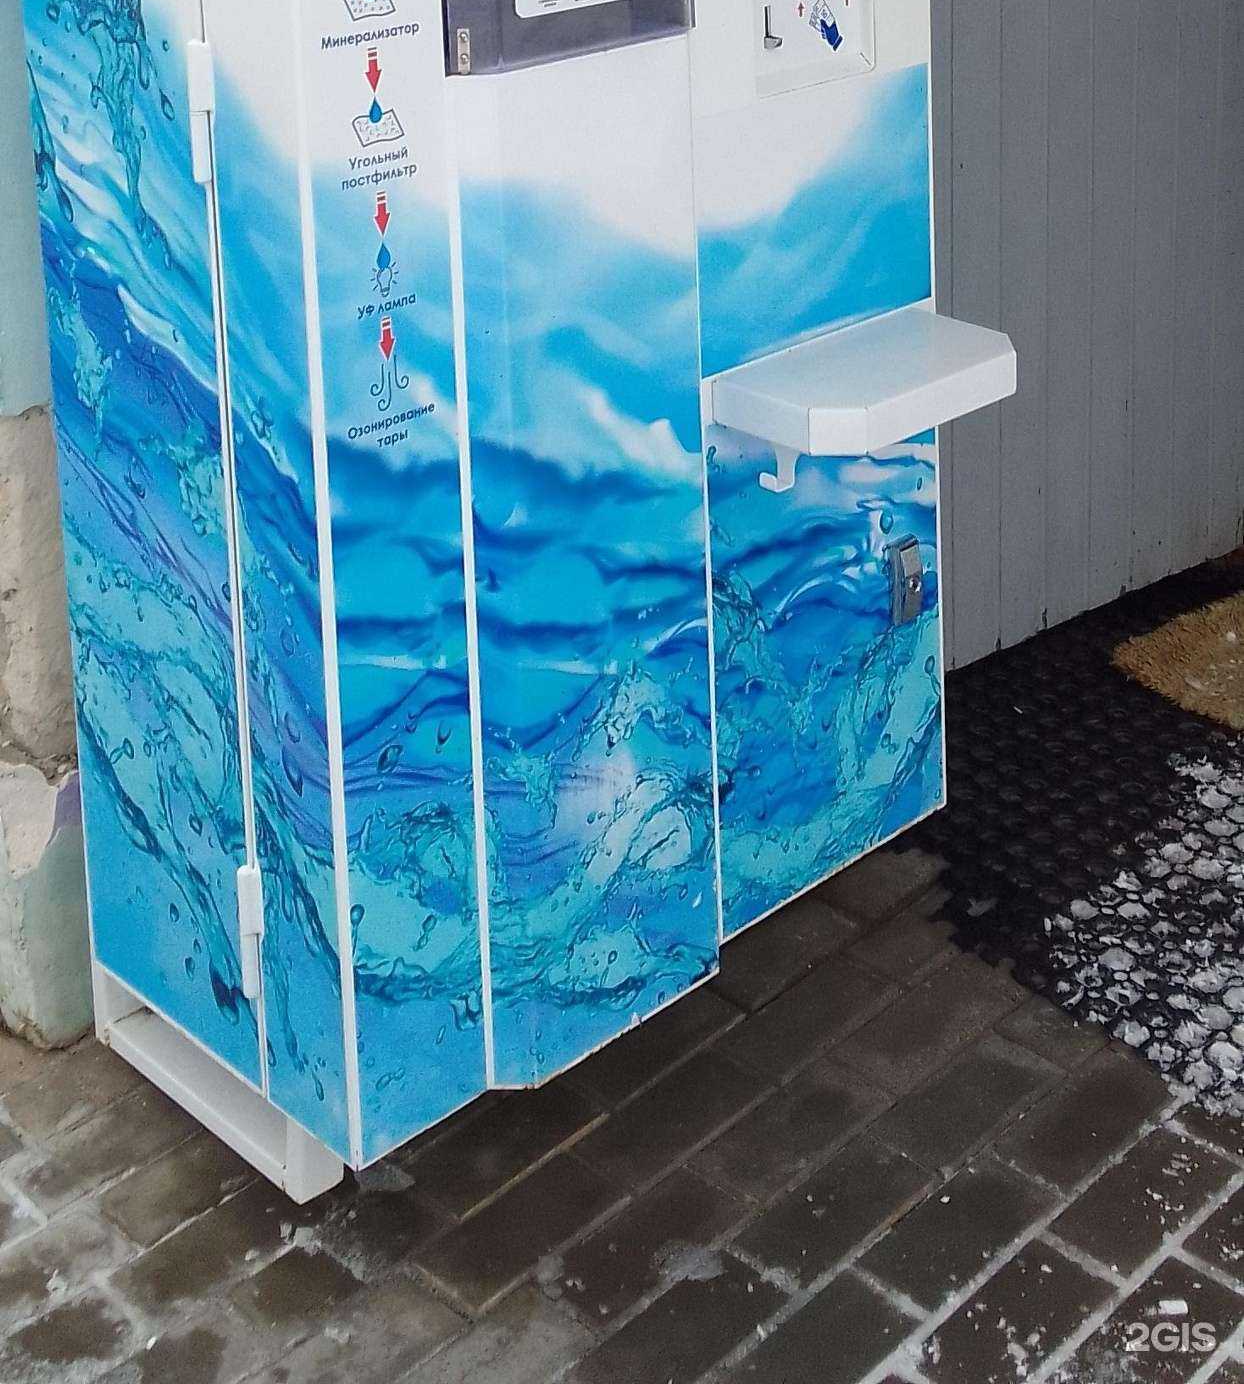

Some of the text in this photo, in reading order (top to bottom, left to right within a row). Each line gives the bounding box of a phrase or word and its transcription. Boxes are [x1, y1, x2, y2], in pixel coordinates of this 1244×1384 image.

[321, 22, 420, 50] Минерализатор
[348, 146, 408, 170] Угольный
[342, 163, 417, 191] постфильтр
[358, 293, 416, 319] УФ лампа
[348, 402, 436, 440] Озонирование
[376, 429, 408, 448] тары
